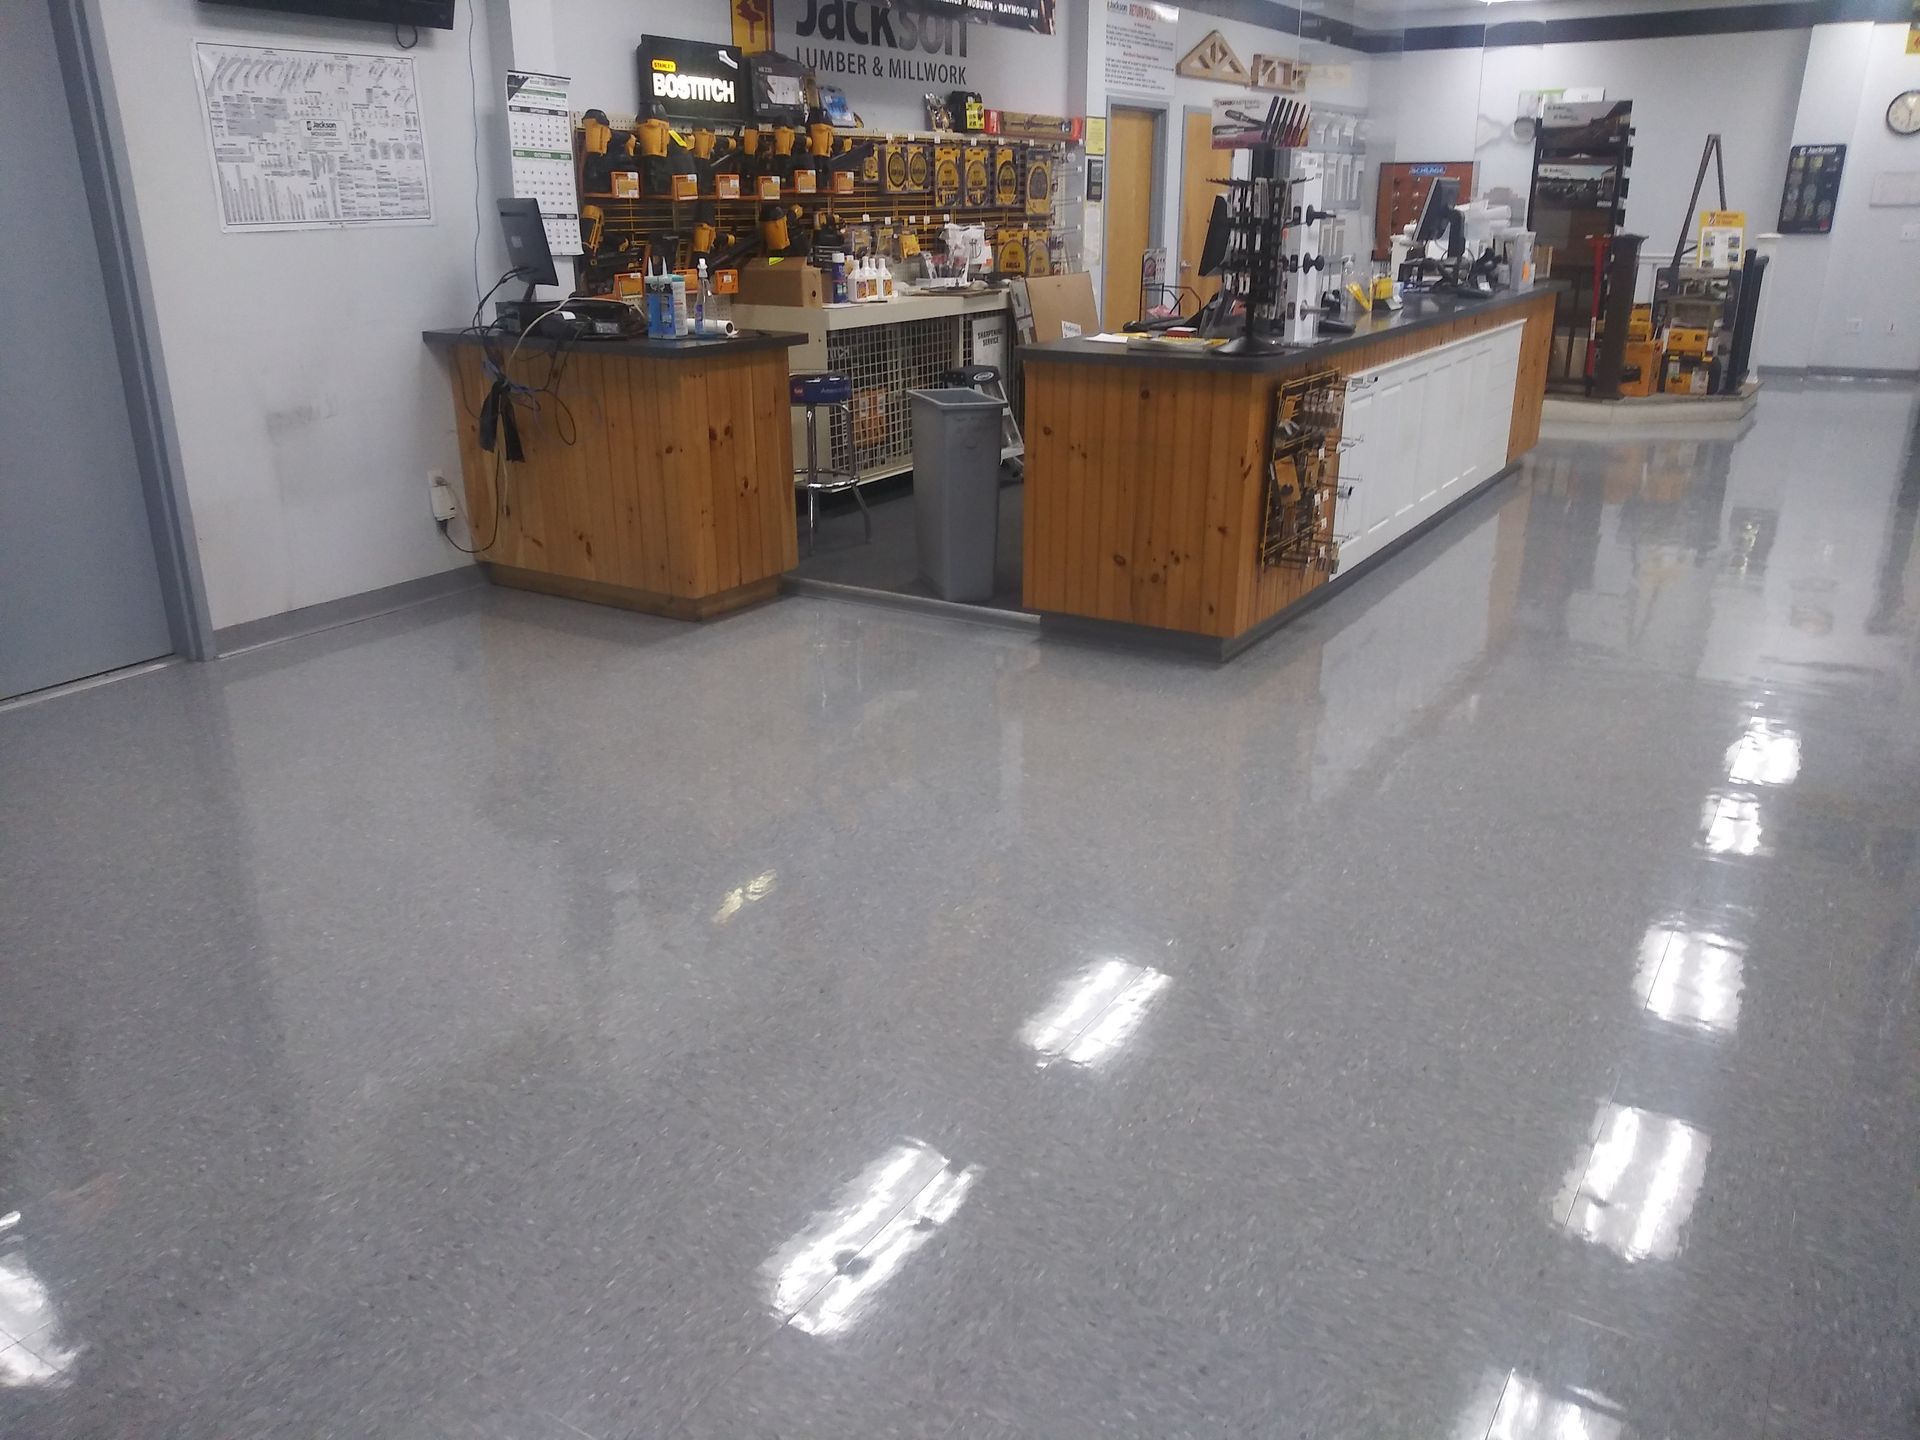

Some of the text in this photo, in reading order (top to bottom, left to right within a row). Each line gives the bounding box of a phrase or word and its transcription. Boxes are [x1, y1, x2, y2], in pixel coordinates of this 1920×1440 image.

[796, 46, 967, 86] LUMBER & MILLWORK
[652, 73, 736, 104] BOSTITCH
[977, 328, 1004, 340] SHARPEN
